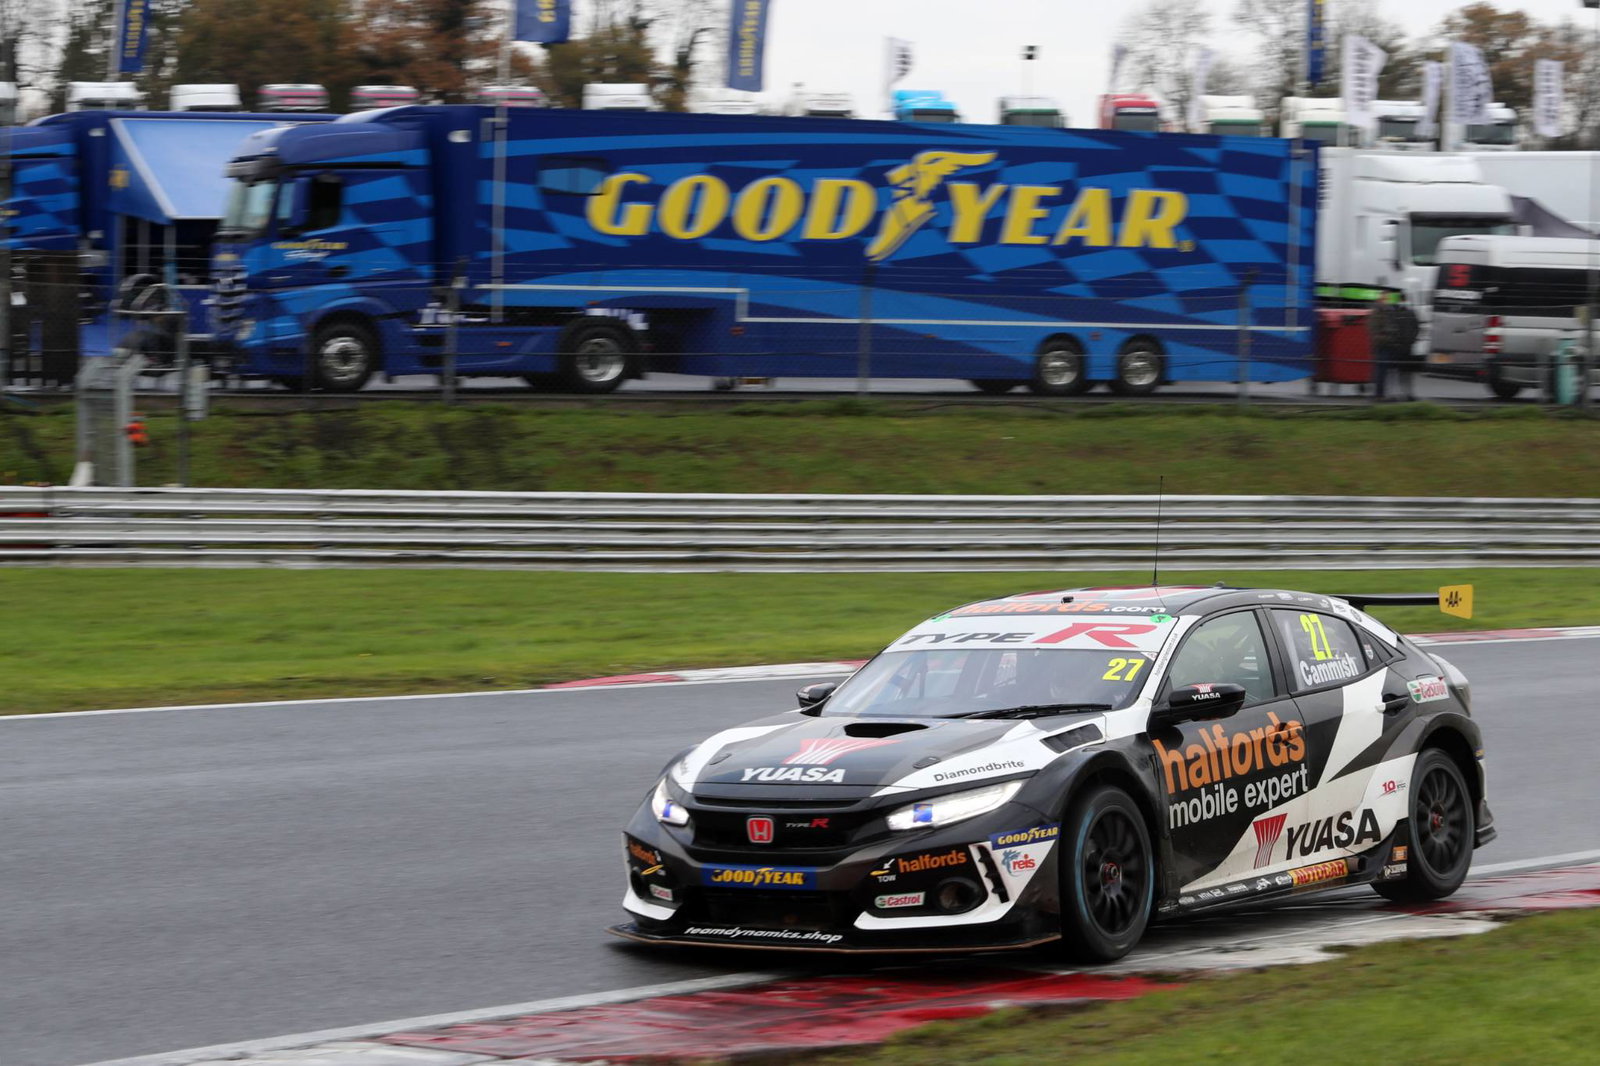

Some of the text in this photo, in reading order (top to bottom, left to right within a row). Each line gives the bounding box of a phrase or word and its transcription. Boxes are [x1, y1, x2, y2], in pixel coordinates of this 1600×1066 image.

[902, 622, 1158, 648] TYPE R
[1299, 613, 1334, 661] 27
[1102, 658, 1145, 682] 27
[1300, 653, 1358, 686] Cammish
[1191, 691, 1221, 701] YUASA
[1152, 711, 1306, 794] halfords
[740, 767, 846, 783] YUASA
[933, 759, 1025, 782] Diamondbrite
[1169, 763, 1309, 829] mobile expert
[997, 826, 1059, 845] GOODYEAR
[1285, 808, 1382, 861] YUASA
[898, 850, 967, 873] halfords
[1012, 853, 1036, 871] reis
[1294, 859, 1345, 885] AUTOCAR
[711, 867, 804, 886] GOODYEAR
[877, 874, 897, 883] TOW
[885, 893, 921, 907] Castrol
[684, 926, 843, 943] teamdynamics.shop
